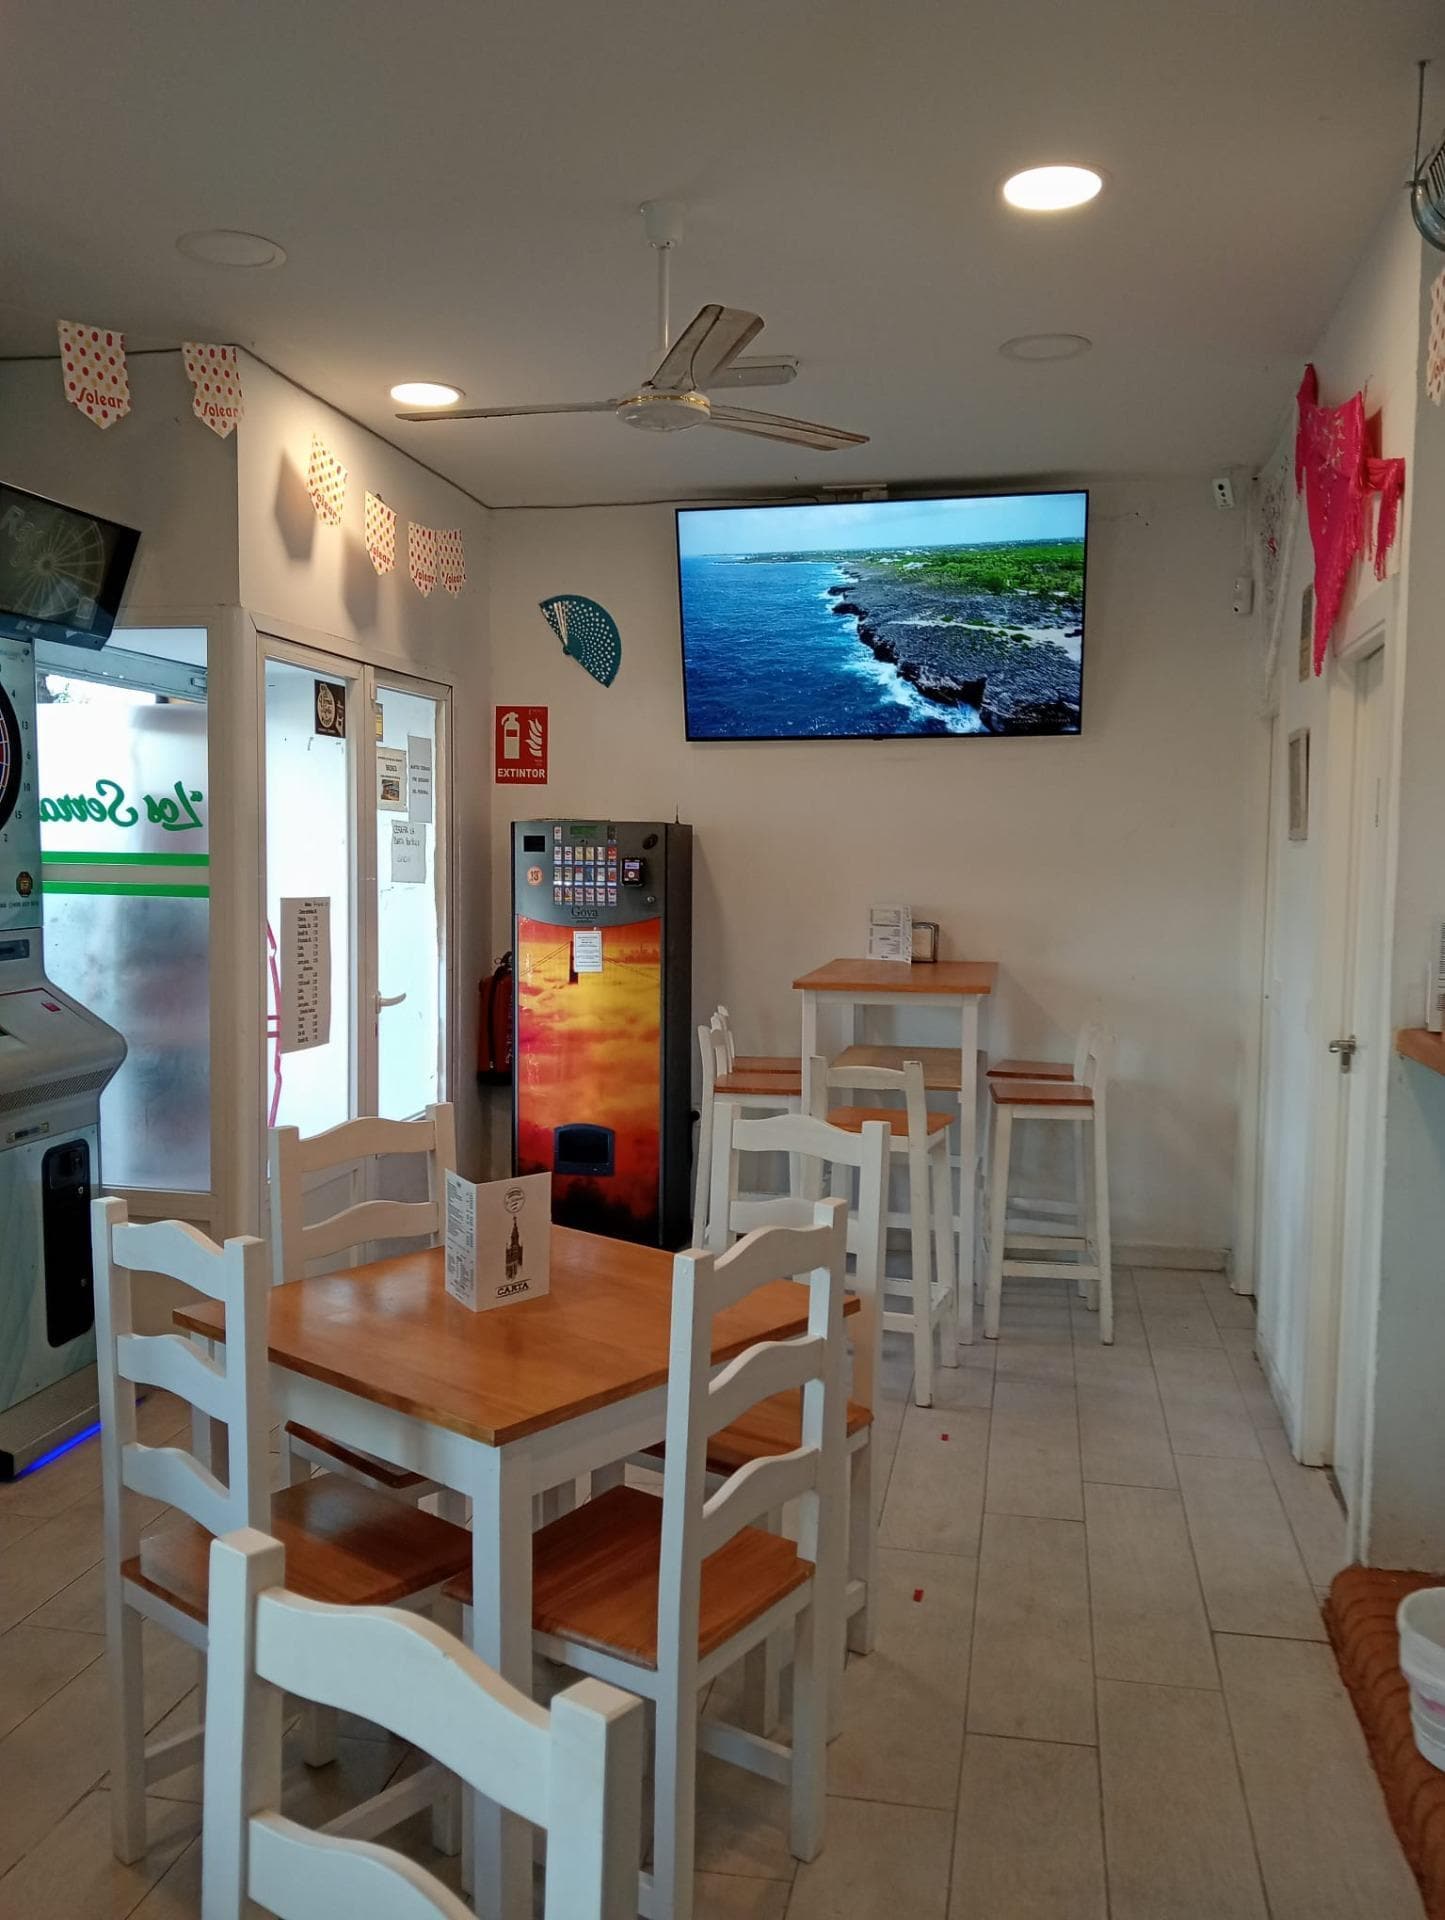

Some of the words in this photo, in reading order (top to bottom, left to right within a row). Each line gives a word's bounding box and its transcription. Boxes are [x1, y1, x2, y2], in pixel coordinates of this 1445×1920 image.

[76, 387, 124, 410] Solear
[201, 400, 239, 418] Solear
[312, 486, 338, 519] Solear
[370, 542, 391, 566] Solear
[413, 568, 435, 584] Solear
[444, 570, 463, 584] Solear
[497, 768, 546, 779] EXTINTOR
[497, 1281, 530, 1296] CARTA
